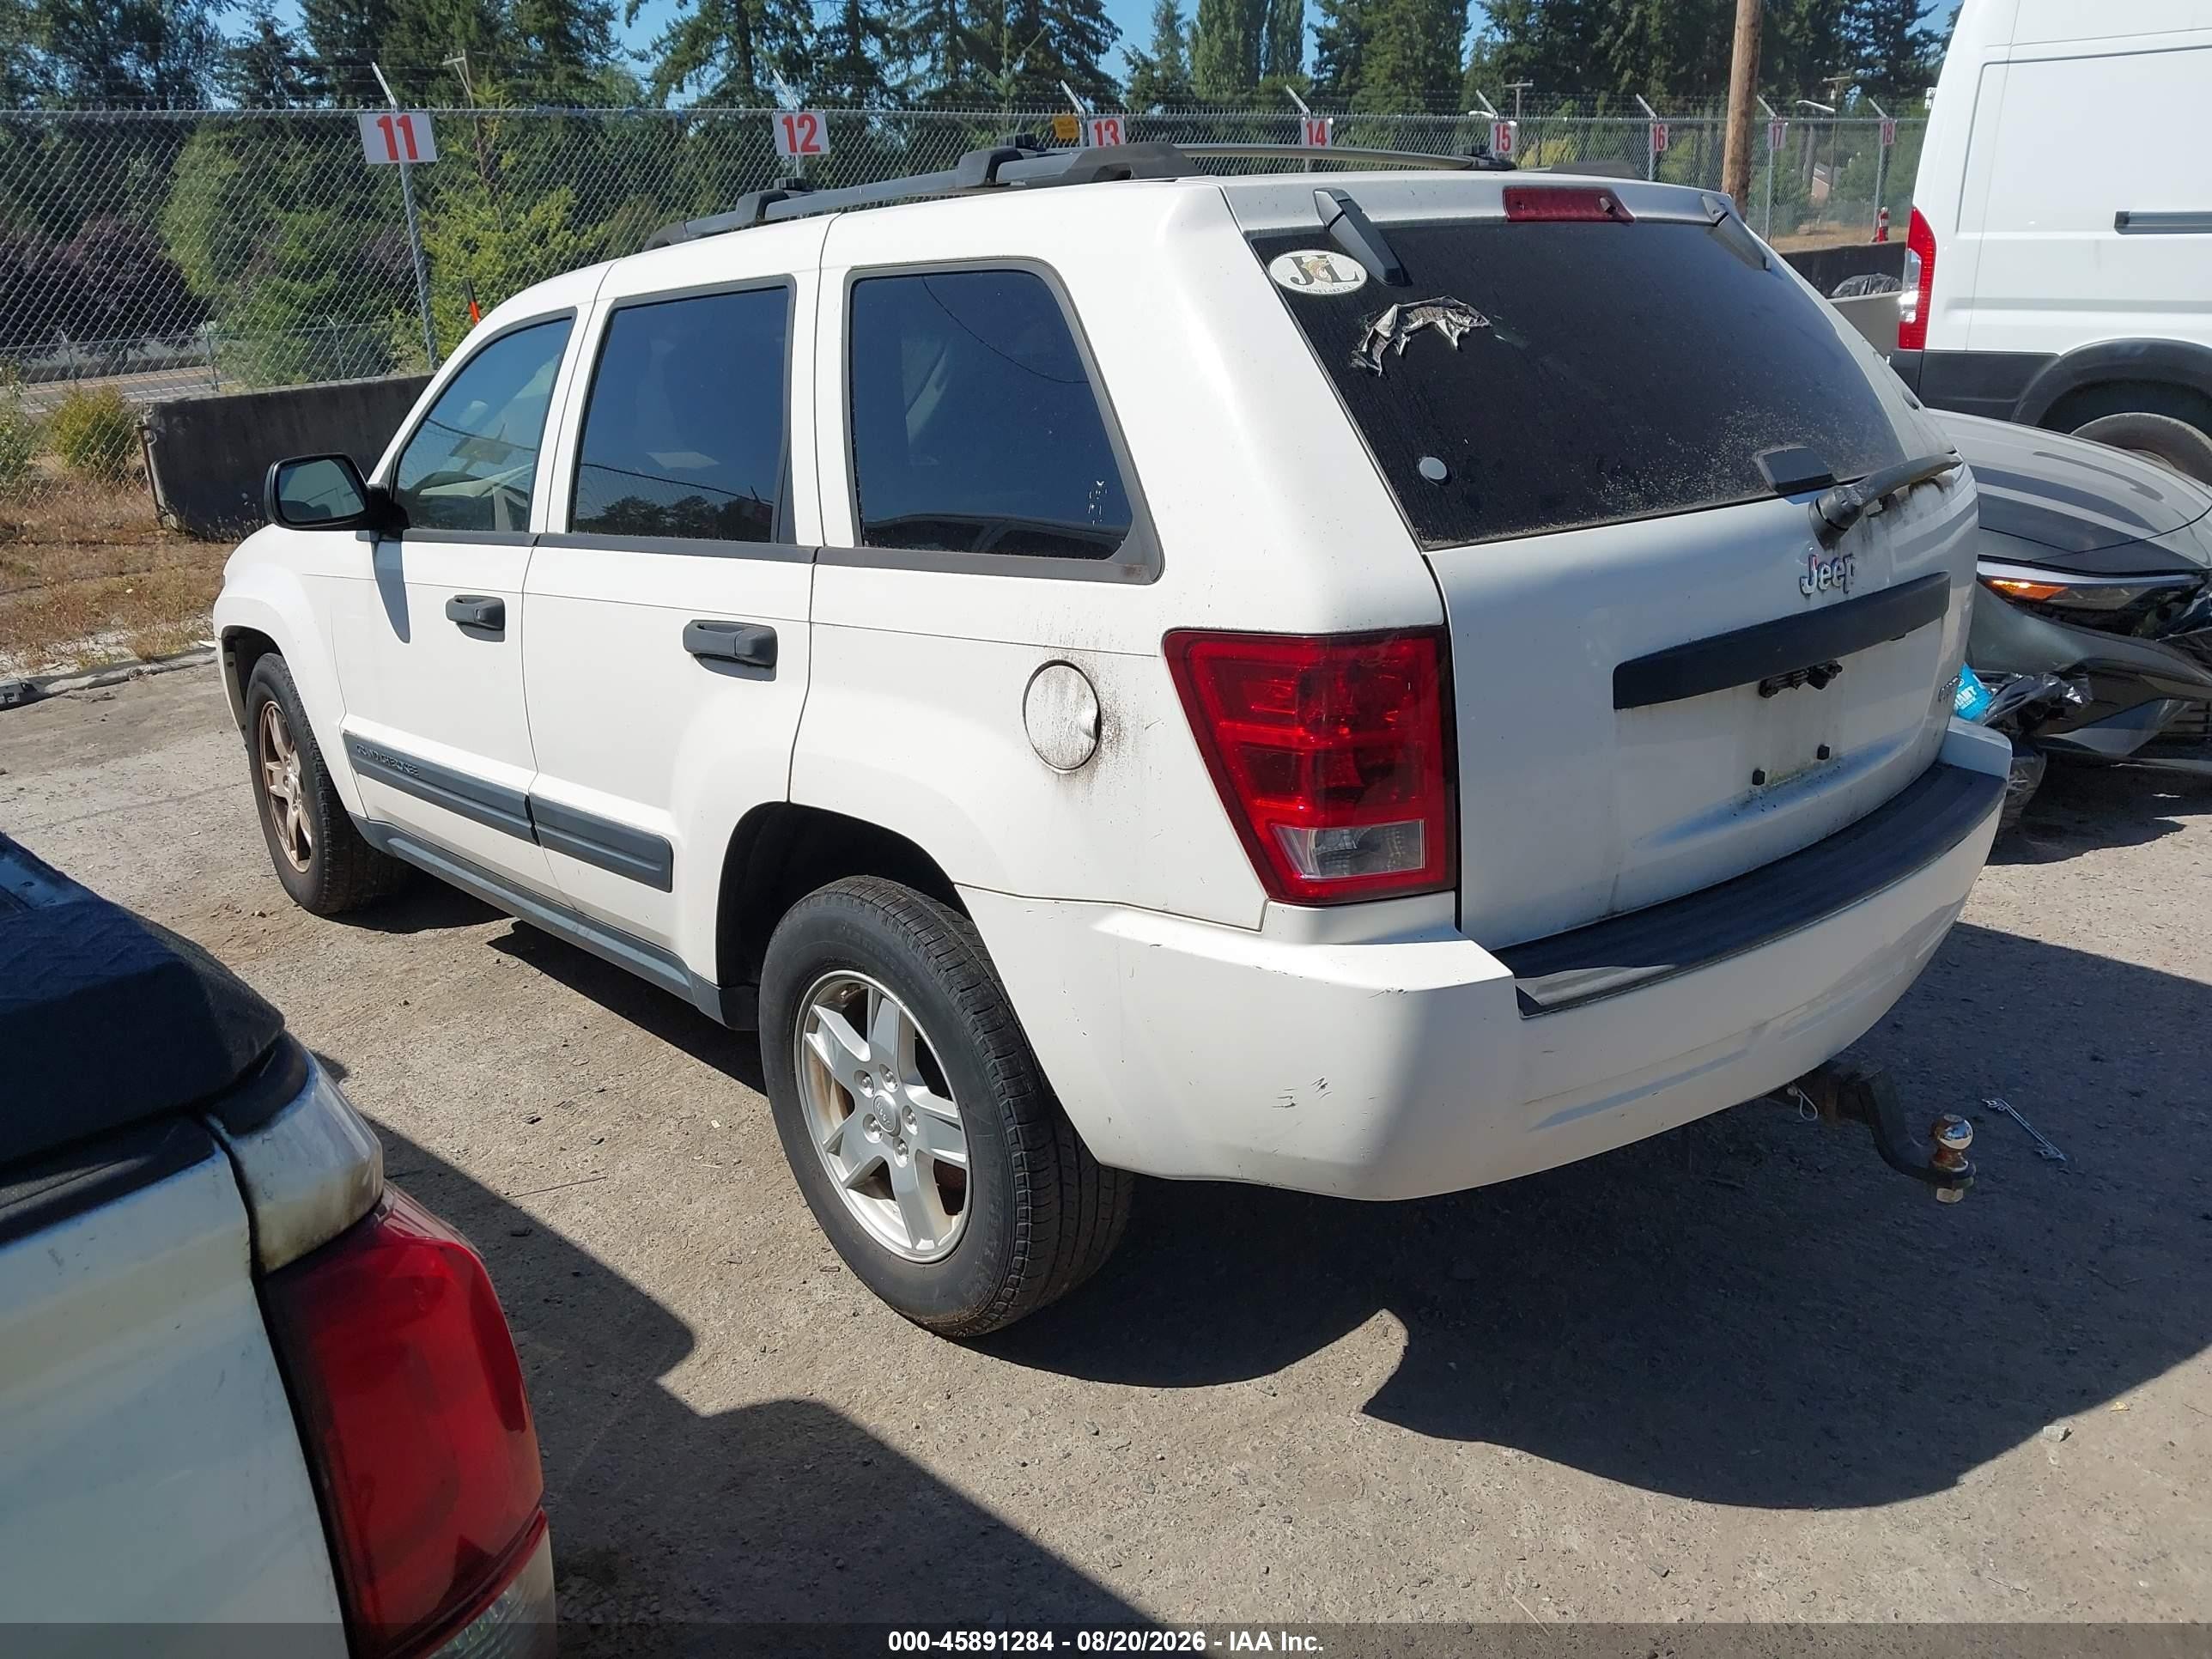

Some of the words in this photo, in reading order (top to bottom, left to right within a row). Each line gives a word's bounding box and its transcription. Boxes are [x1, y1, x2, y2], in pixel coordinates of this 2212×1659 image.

[376, 114, 418, 161] 11
[782, 114, 821, 152] 12
[1094, 118, 1120, 145] 13
[1306, 120, 1327, 146] 14
[1495, 124, 1511, 152] 15
[1652, 124, 1666, 149] 16
[1771, 123, 1784, 148] 17
[1882, 122, 1893, 144] 18
[1800, 552, 1855, 594] Jeep
